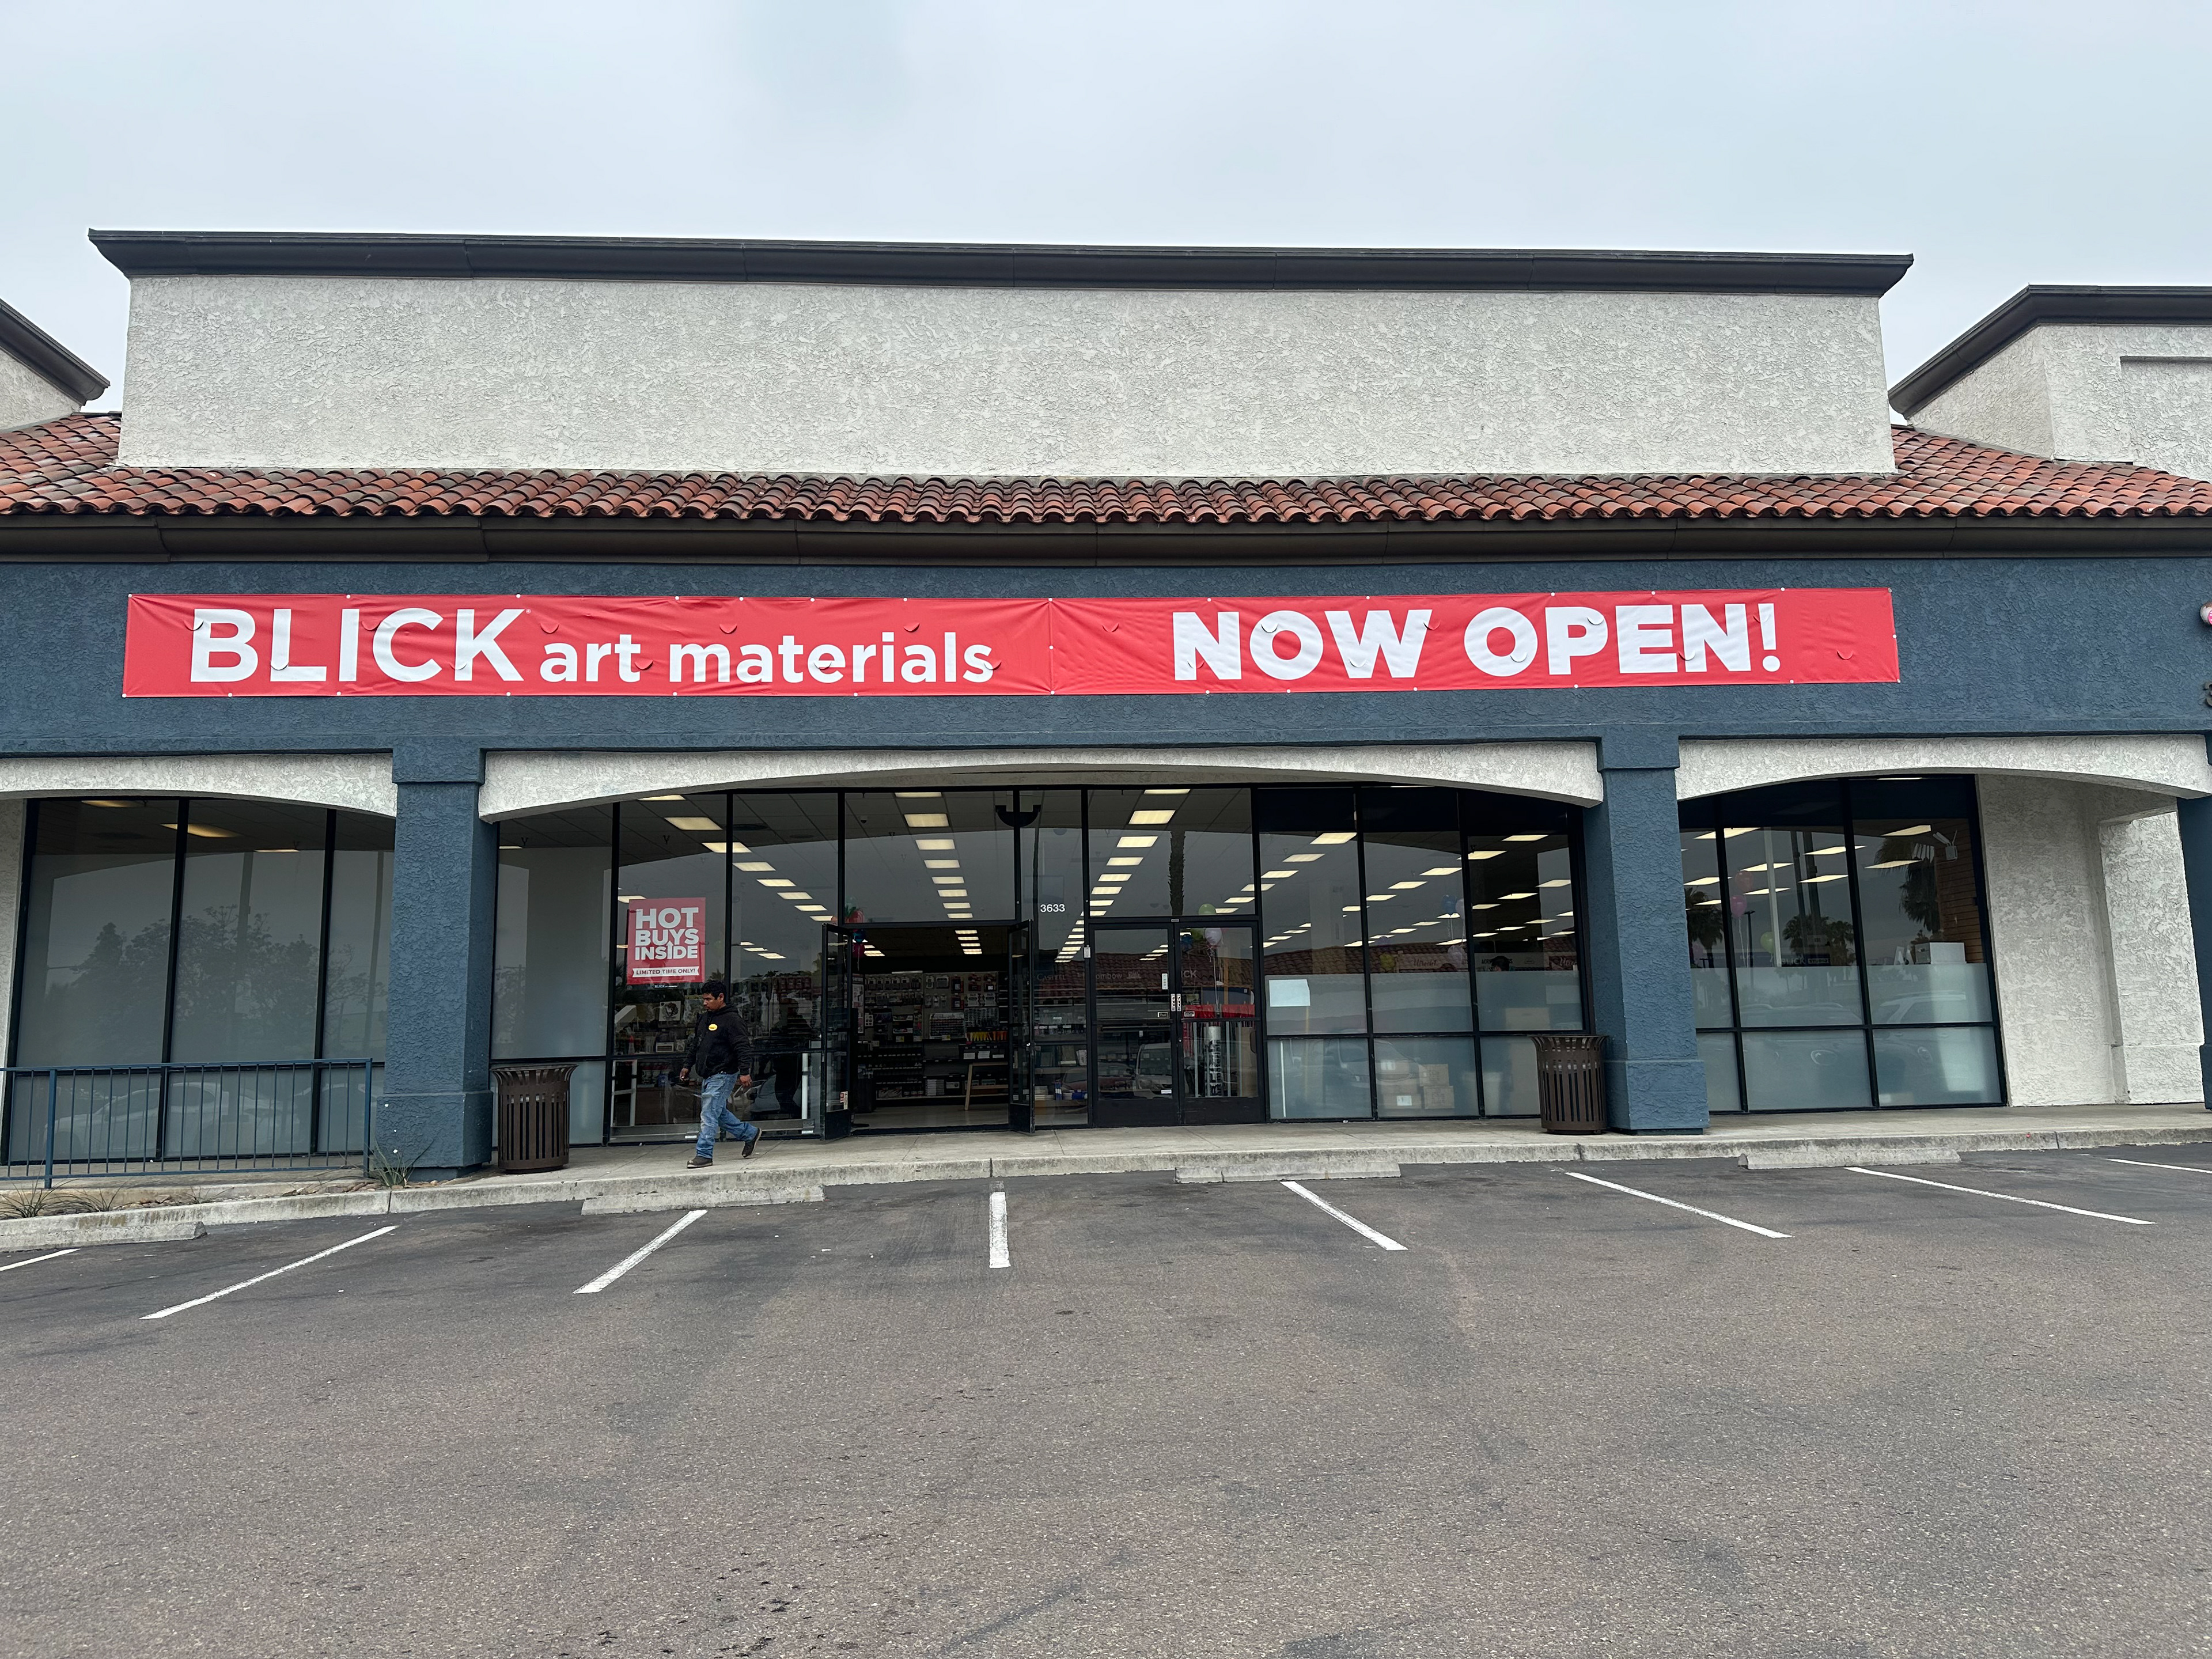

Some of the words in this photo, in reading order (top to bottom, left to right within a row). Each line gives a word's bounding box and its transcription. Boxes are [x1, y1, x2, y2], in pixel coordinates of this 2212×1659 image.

[190, 608, 525, 683] BLICK
[540, 634, 641, 683] art
[669, 632, 994, 684] materials
[1173, 608, 1433, 681] NOW
[1464, 603, 1781, 678] OPEN!
[635, 907, 699, 929] HOT
[1040, 904, 1066, 913] 3633
[635, 928, 699, 946] BUYS
[635, 941, 698, 960] INSIDE
